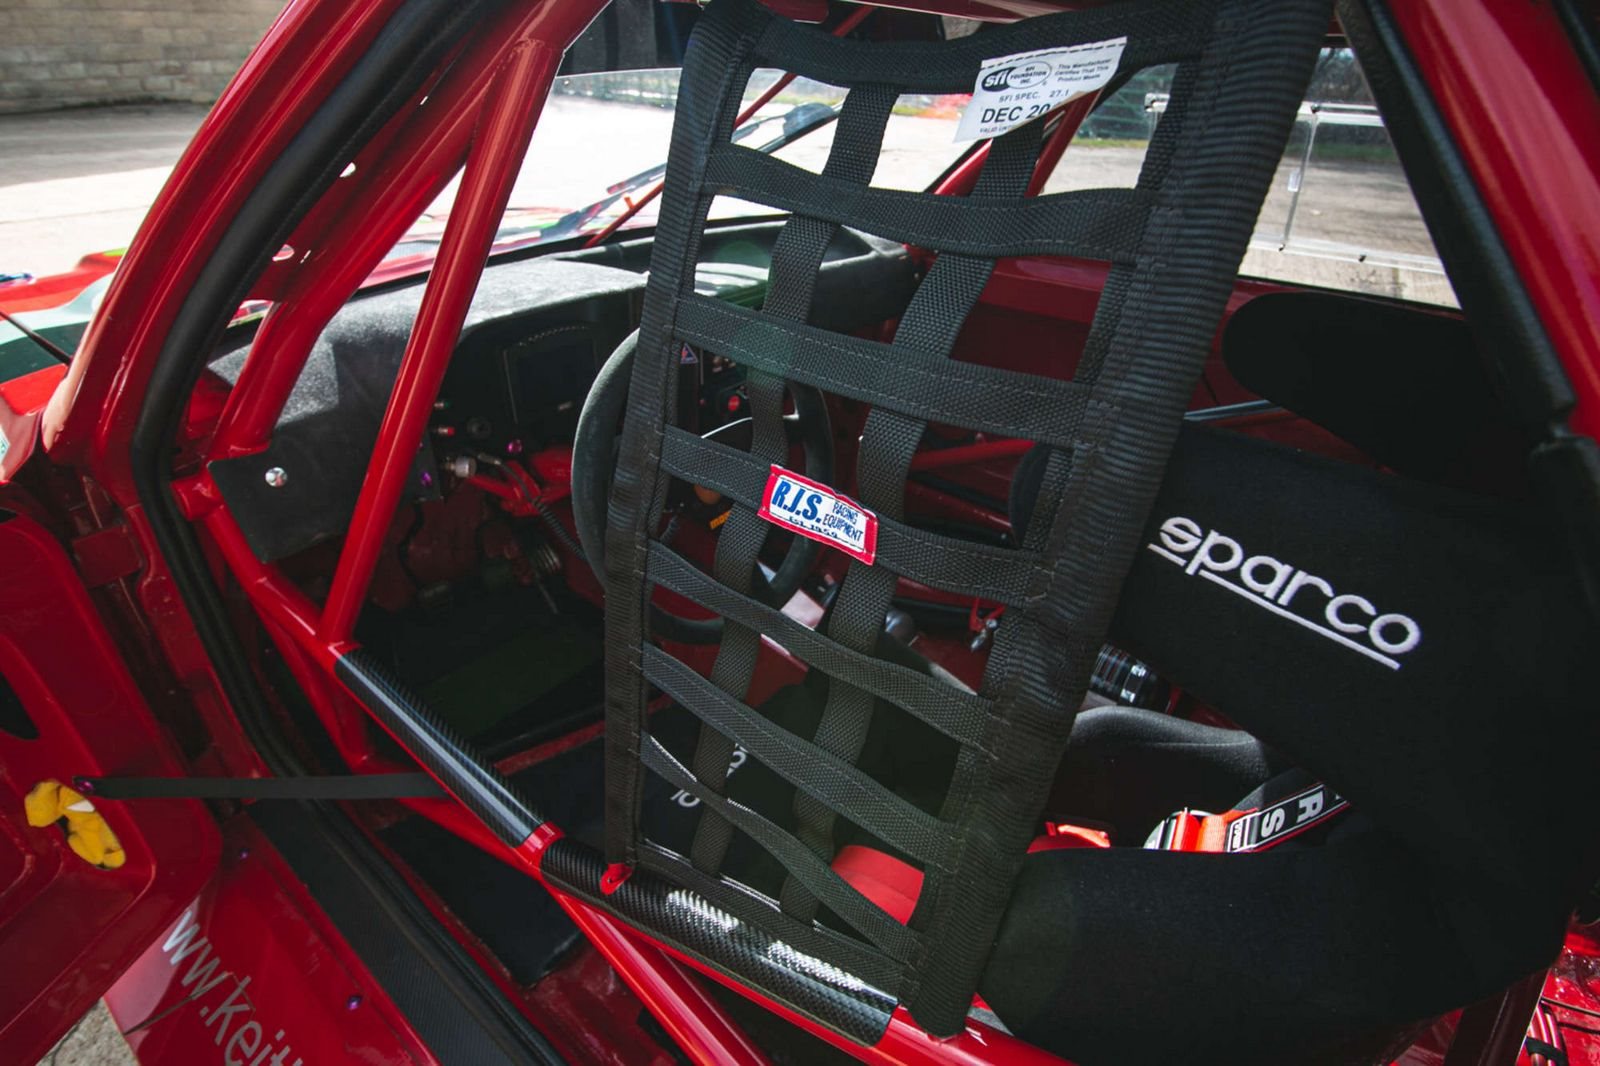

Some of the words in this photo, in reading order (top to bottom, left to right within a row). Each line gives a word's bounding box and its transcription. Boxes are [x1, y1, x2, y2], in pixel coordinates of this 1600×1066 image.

[1010, 70, 1047, 80] FOUNDATION
[999, 94, 1013, 103] SFI
[1015, 91, 1040, 101] SPEC.
[1050, 89, 1070, 98] 27.1
[981, 106, 1023, 124] DEC
[771, 480, 823, 524] R.J.S.
[832, 501, 859, 526] RACING
[822, 513, 864, 541] EQUIPMENT
[1158, 516, 1421, 655] sparco
